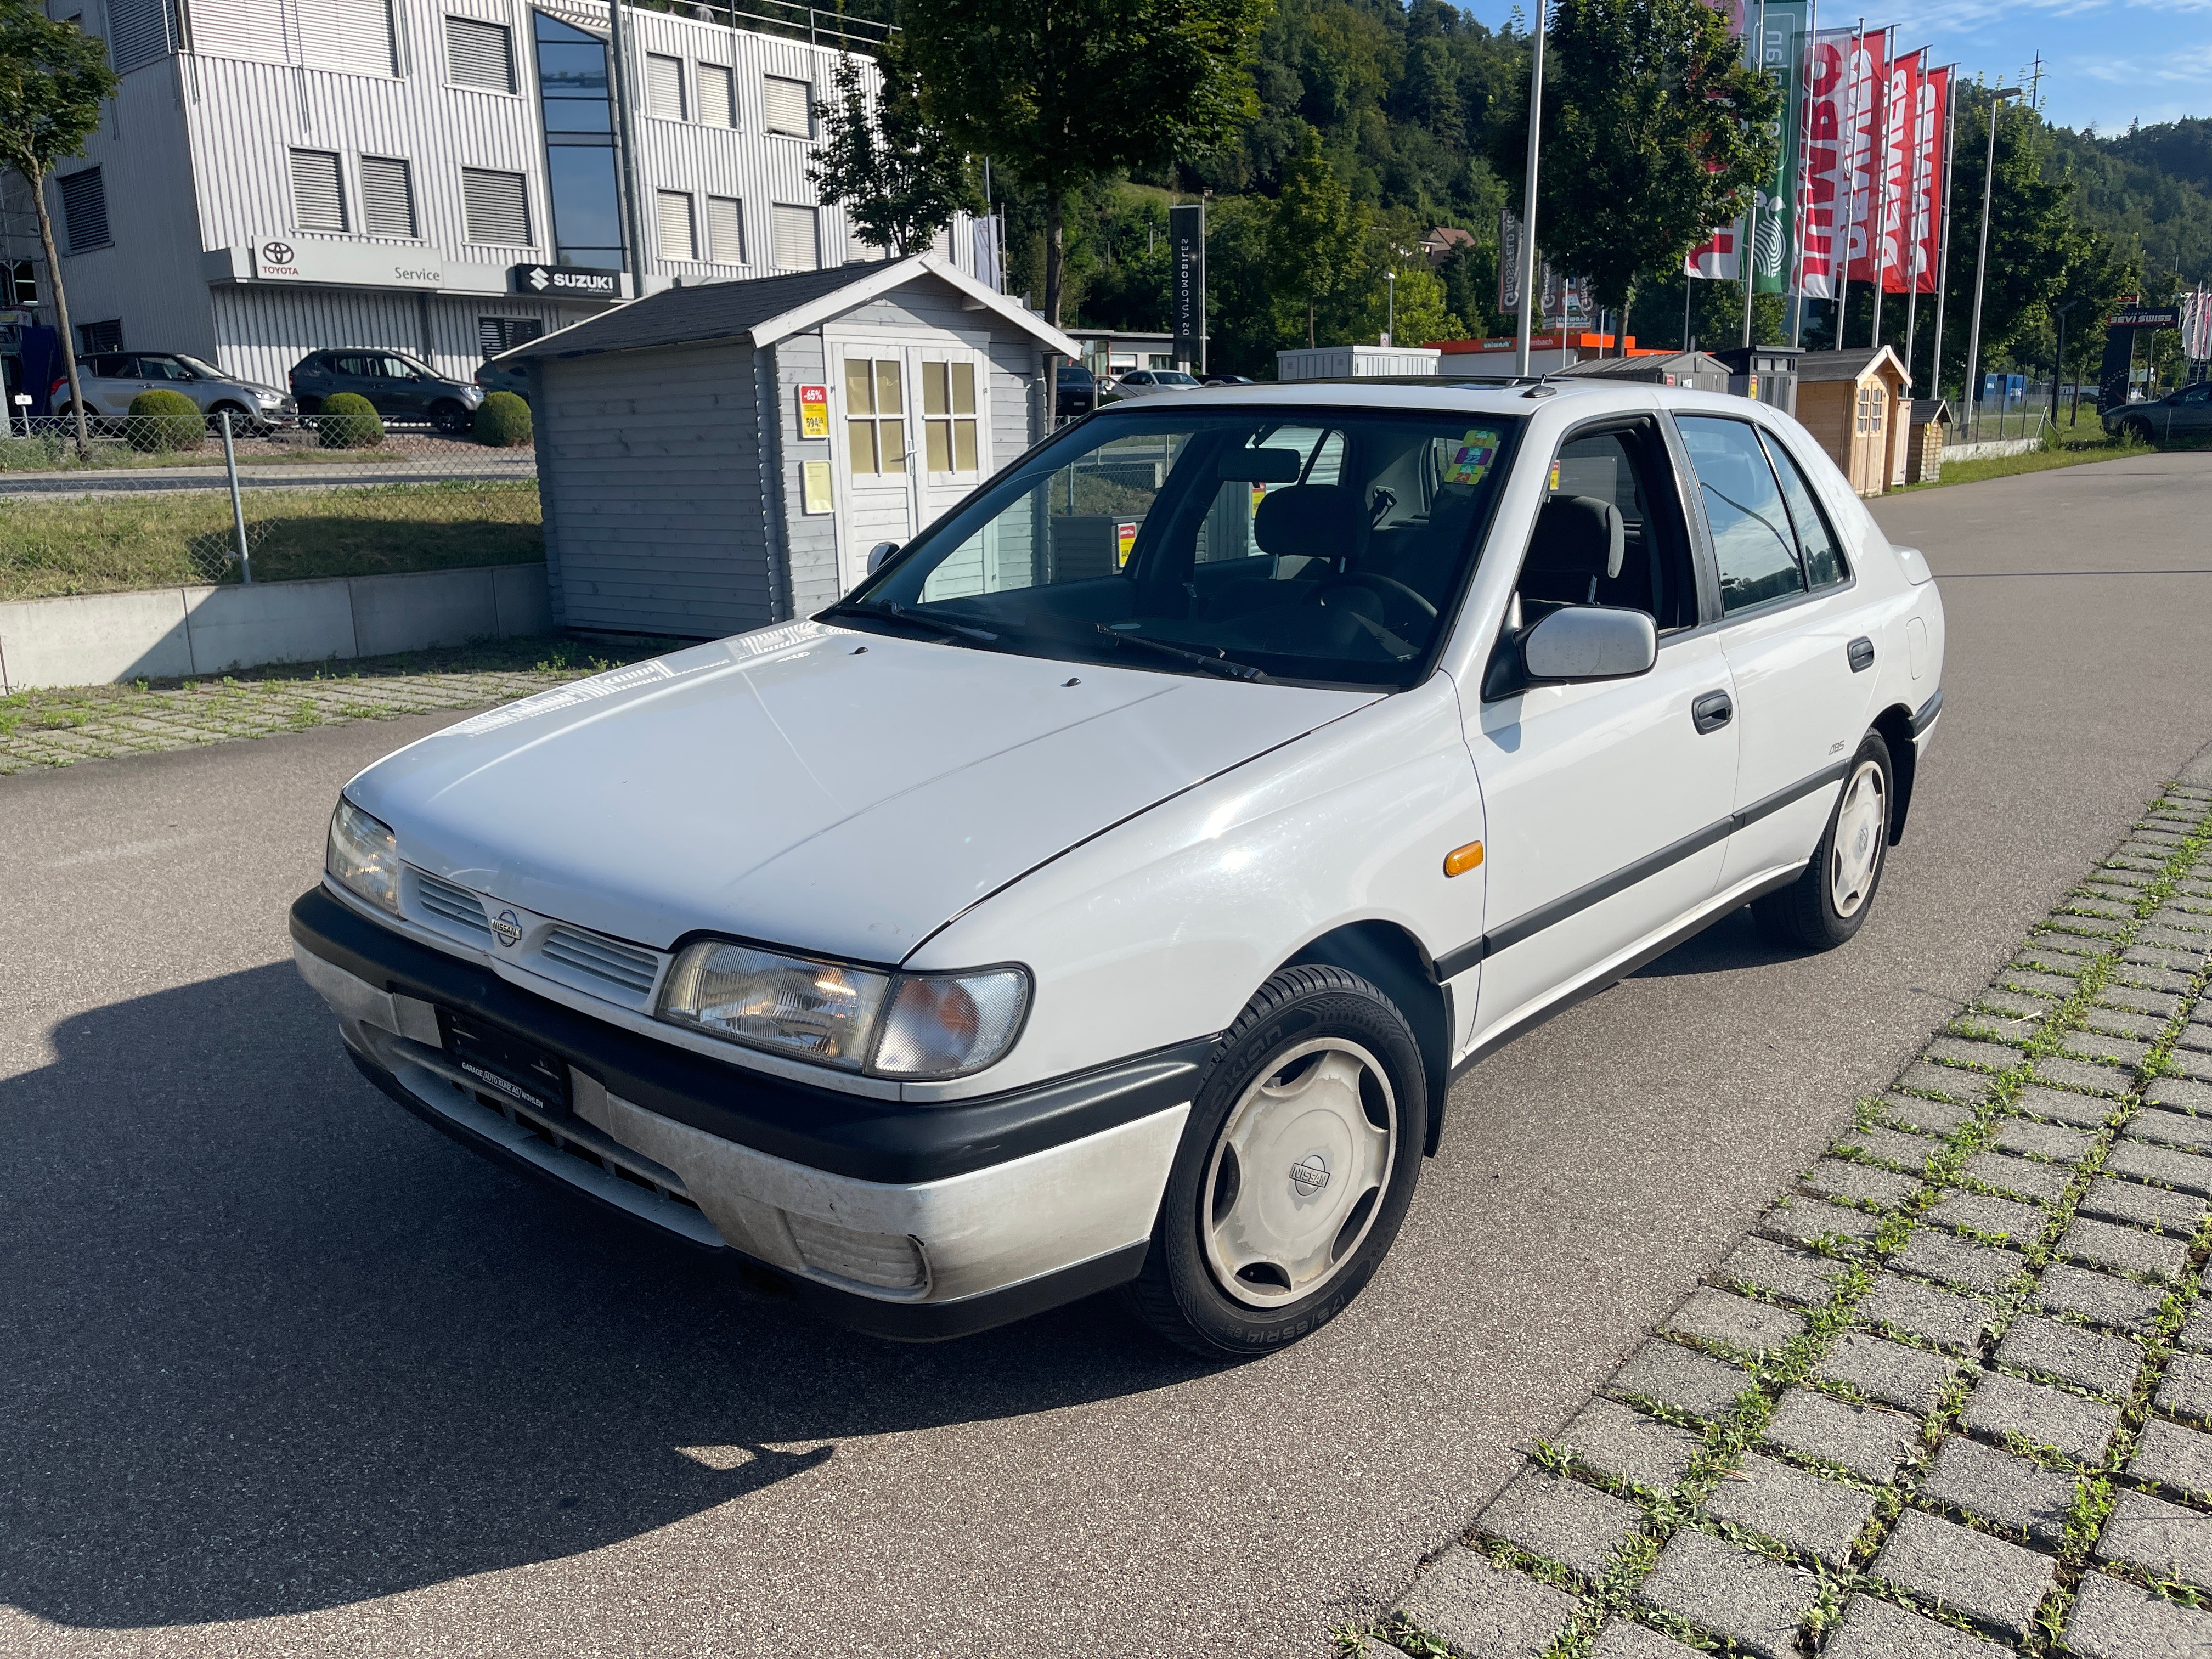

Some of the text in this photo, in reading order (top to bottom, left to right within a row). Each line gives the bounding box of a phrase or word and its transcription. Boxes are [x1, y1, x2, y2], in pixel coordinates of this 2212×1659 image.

[263, 266, 299, 275] TOYOTA
[395, 267, 441, 281] Service
[553, 273, 614, 289] SUZUKI
[2138, 314, 2172, 323] SWISS
[1483, 338, 1554, 348] uniwash mbach
[804, 389, 823, 401] -65%
[1454, 473, 1471, 482] 23
[1828, 740, 1845, 756] ABS
[493, 921, 517, 936] NISSAN
[462, 1062, 483, 1077] GARAGE
[484, 1073, 498, 1084] AUTO
[498, 1080, 511, 1091] KUNZ
[521, 1091, 543, 1109] WOHLEN
[1291, 1166, 1327, 1186] NISSAN
